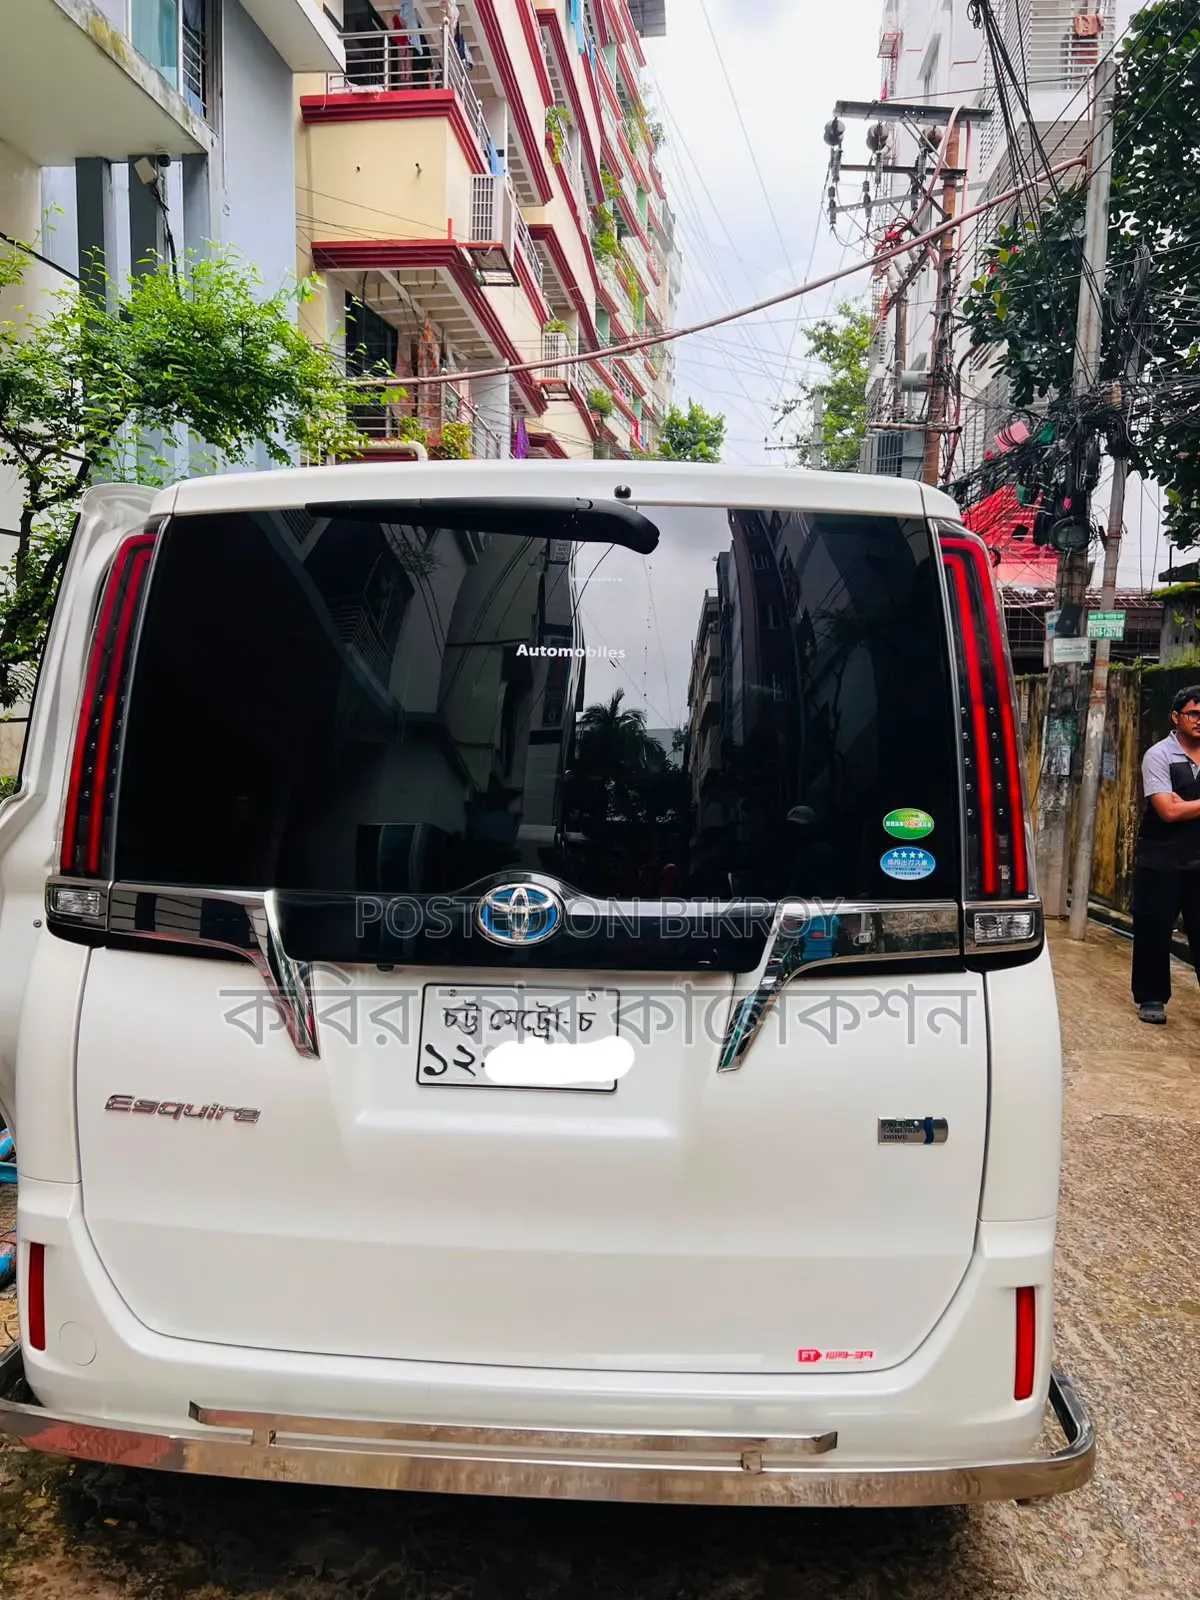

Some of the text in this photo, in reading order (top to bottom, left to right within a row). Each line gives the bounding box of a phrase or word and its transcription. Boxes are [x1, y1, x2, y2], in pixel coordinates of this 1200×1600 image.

[515, 644, 626, 659] Automobiles
[104, 1094, 262, 1124] Esquire
[801, 1351, 817, 1361] FT
